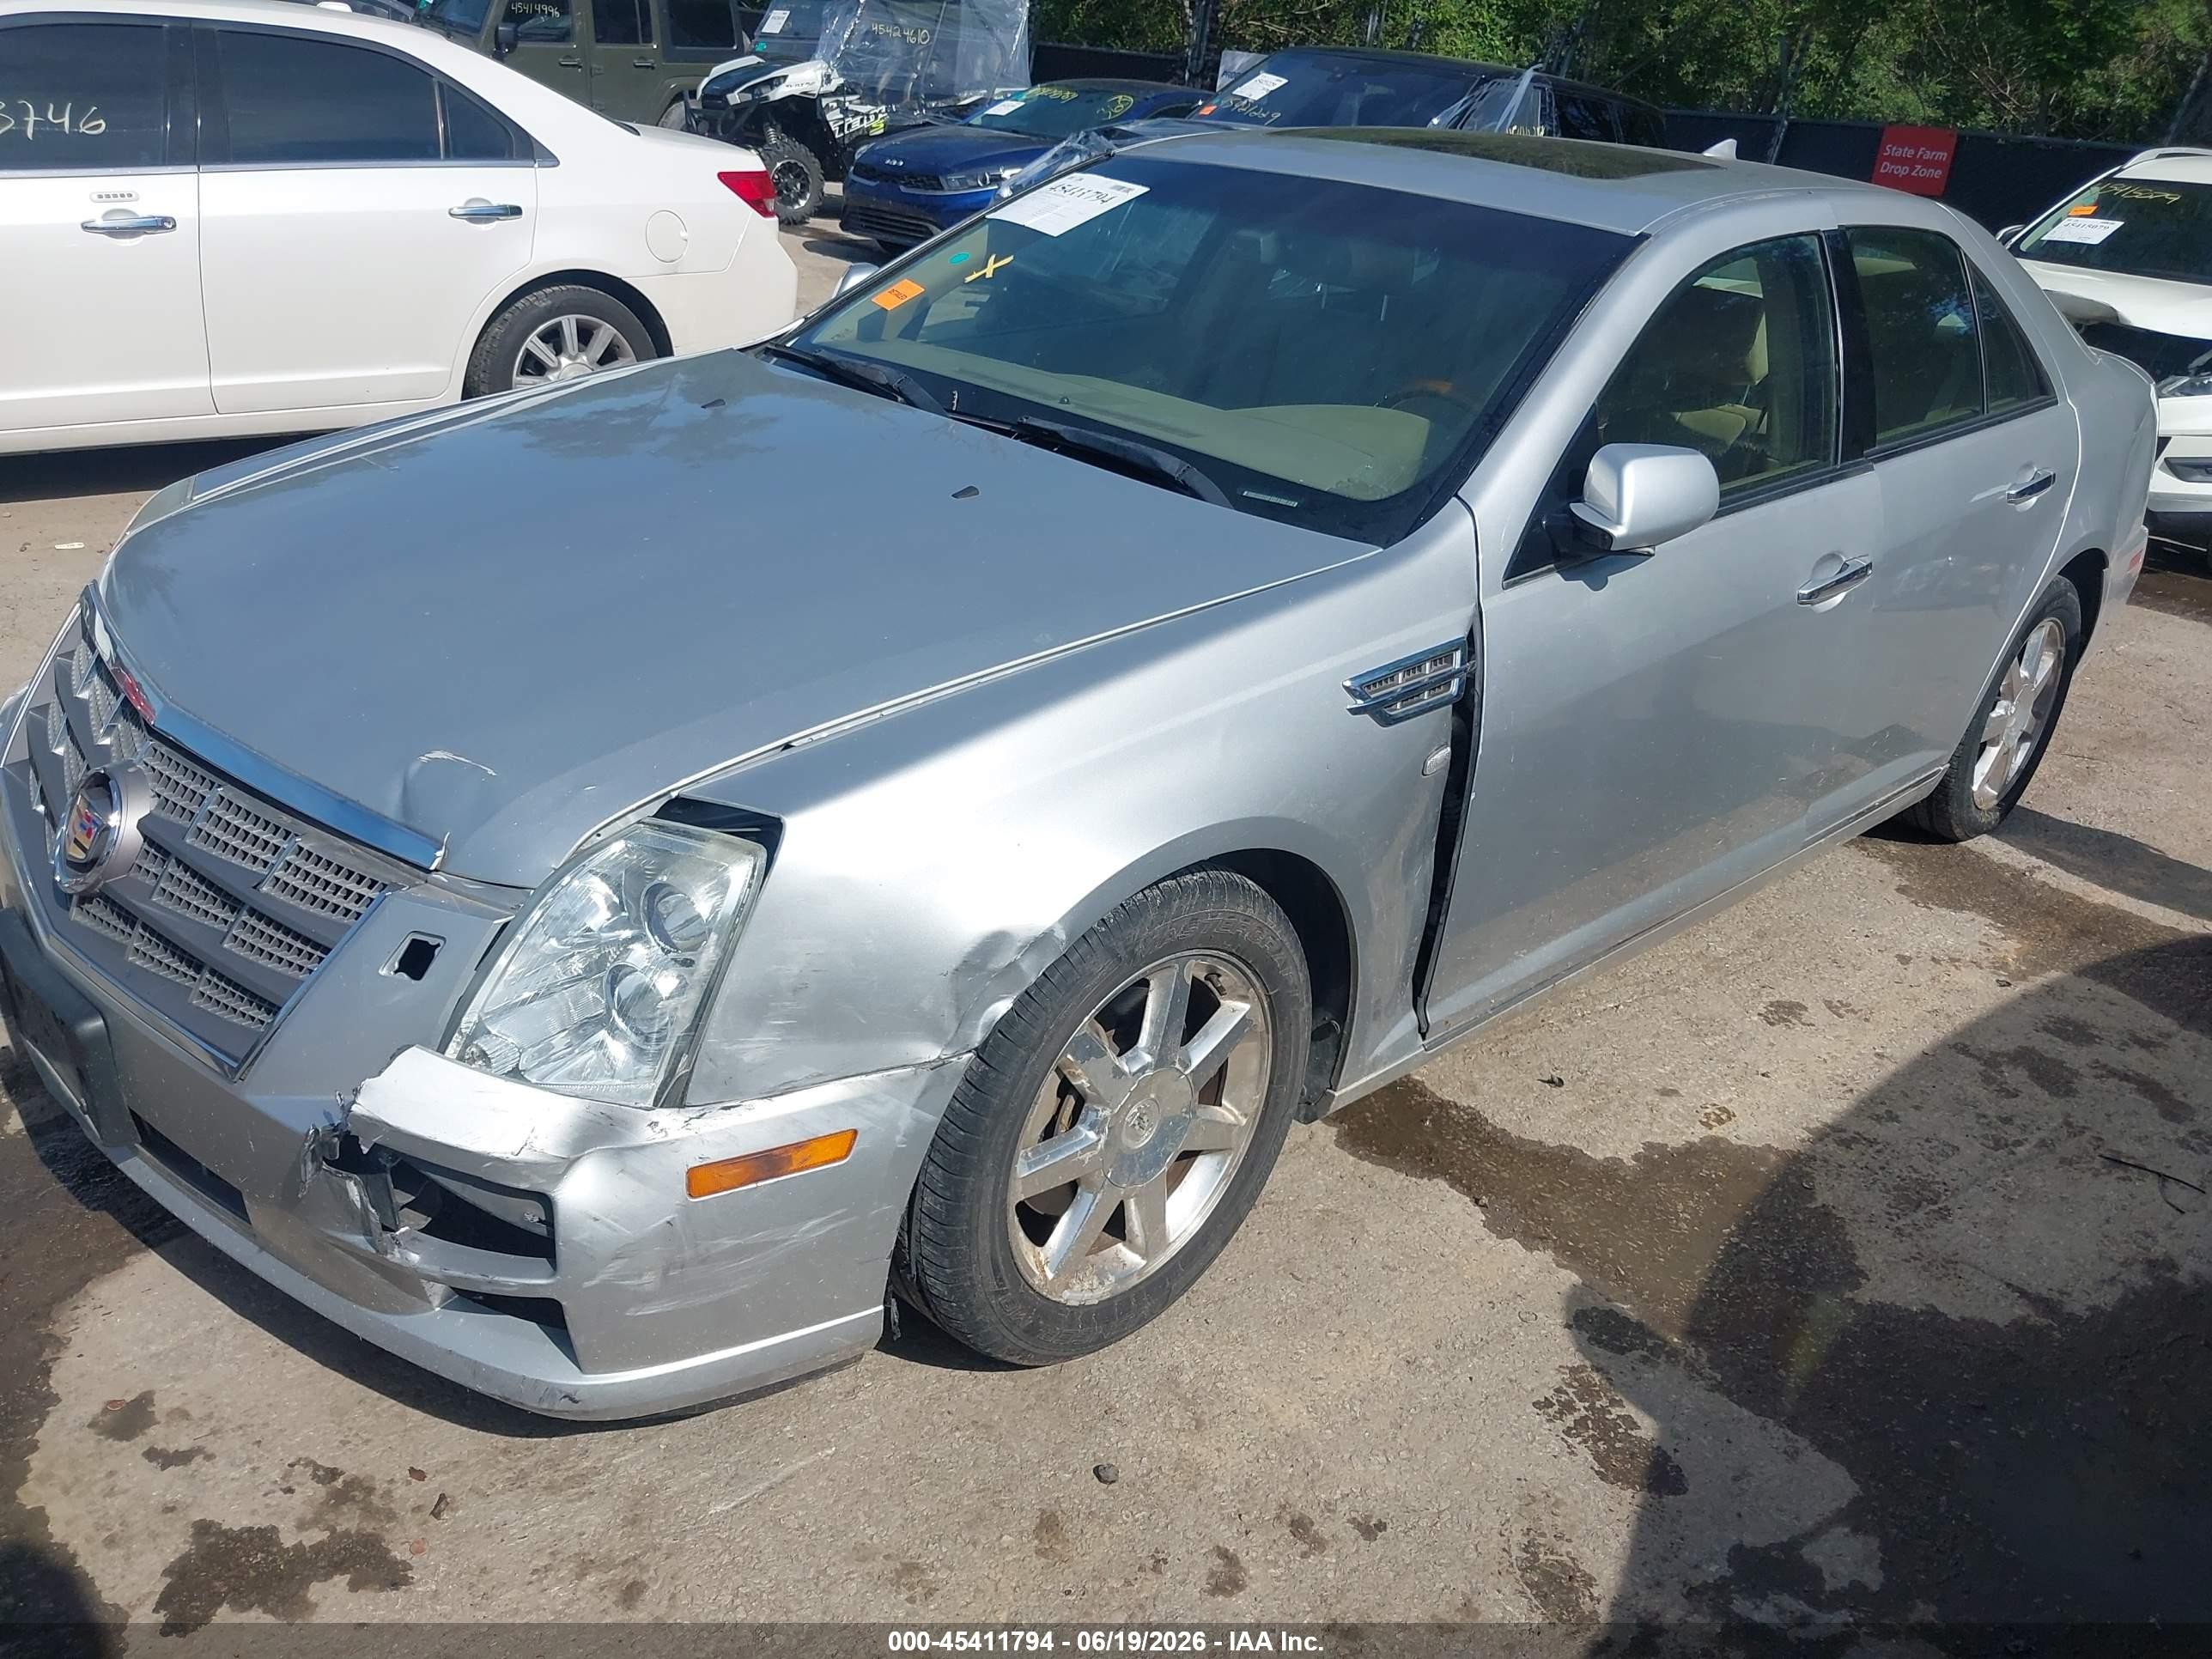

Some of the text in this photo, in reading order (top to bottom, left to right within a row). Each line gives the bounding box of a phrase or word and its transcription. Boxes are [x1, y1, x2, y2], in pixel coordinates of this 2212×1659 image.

[1883, 144, 1948, 161] State Farm
[1881, 161, 1942, 179] Drop Zone
